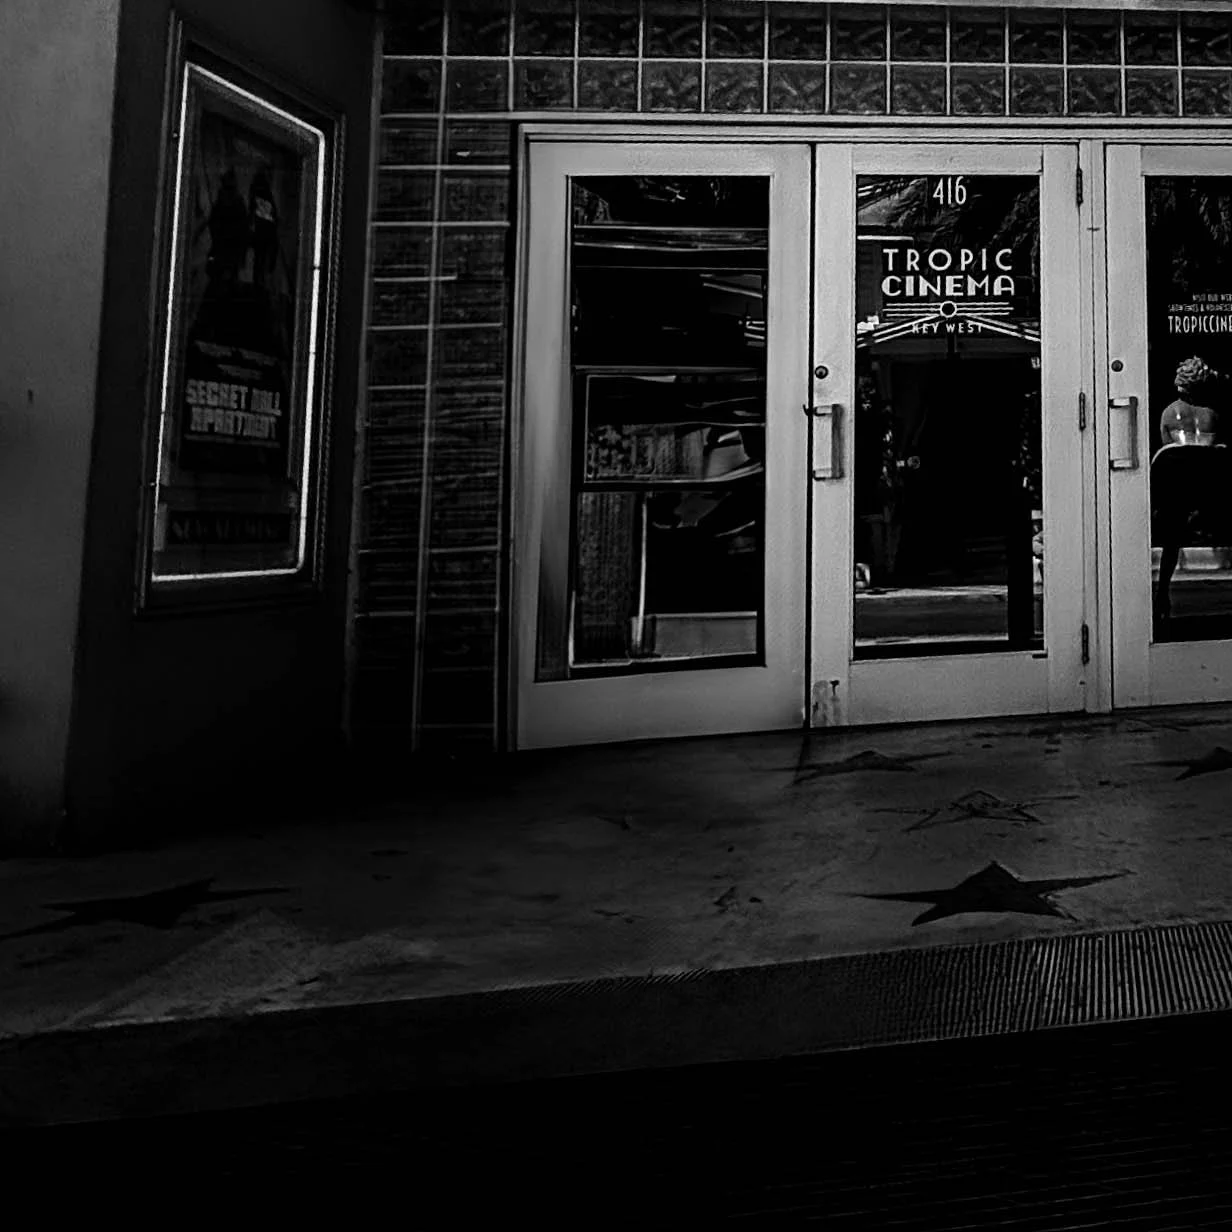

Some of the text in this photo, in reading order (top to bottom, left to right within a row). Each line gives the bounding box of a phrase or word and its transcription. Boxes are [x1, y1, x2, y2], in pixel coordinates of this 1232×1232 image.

[933, 176, 967, 206] 416
[882, 248, 1013, 271] TROPIC
[880, 275, 1015, 297] CINEMA
[911, 323, 983, 334] KEY WEST
[186, 378, 248, 410] SECRET
